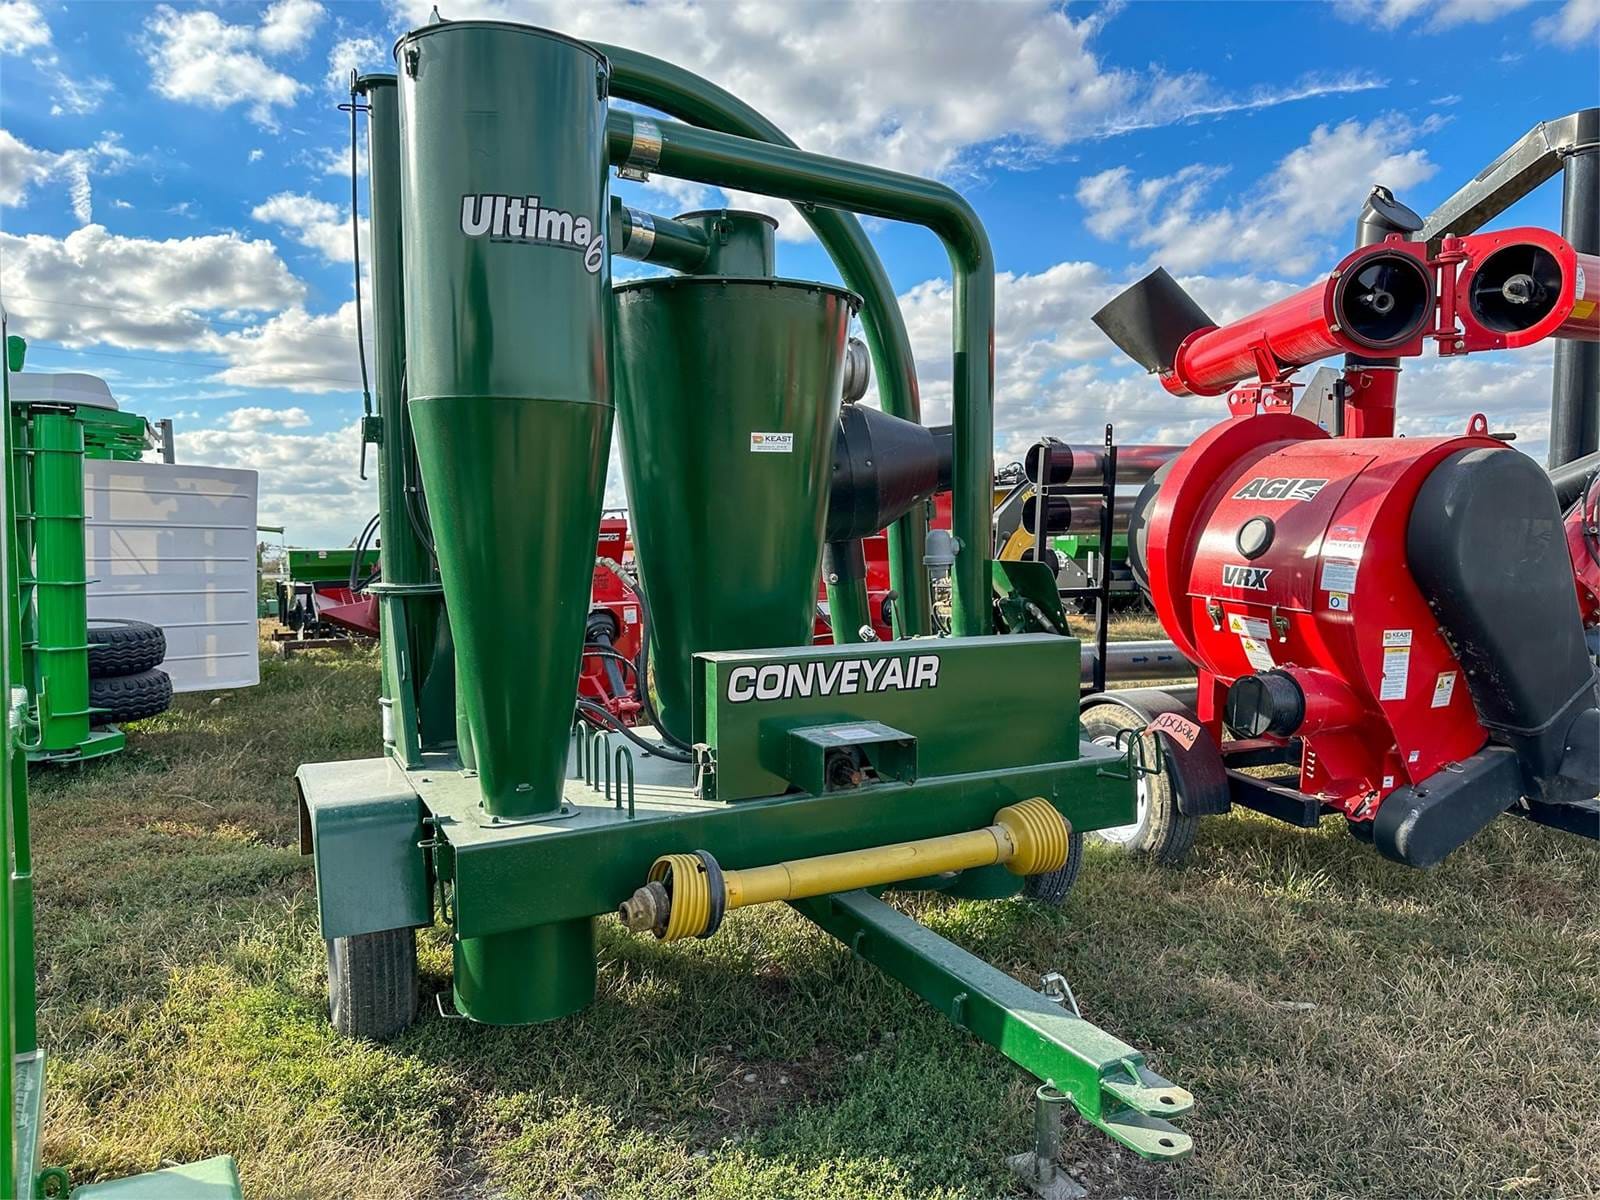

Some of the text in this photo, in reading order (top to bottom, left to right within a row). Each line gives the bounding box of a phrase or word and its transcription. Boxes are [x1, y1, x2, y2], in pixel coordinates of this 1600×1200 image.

[460, 194, 604, 274] Ultima 6
[1236, 478, 1295, 499] AGI
[1223, 566, 1271, 589] VRX
[727, 655, 941, 703] CONVEYAIR
